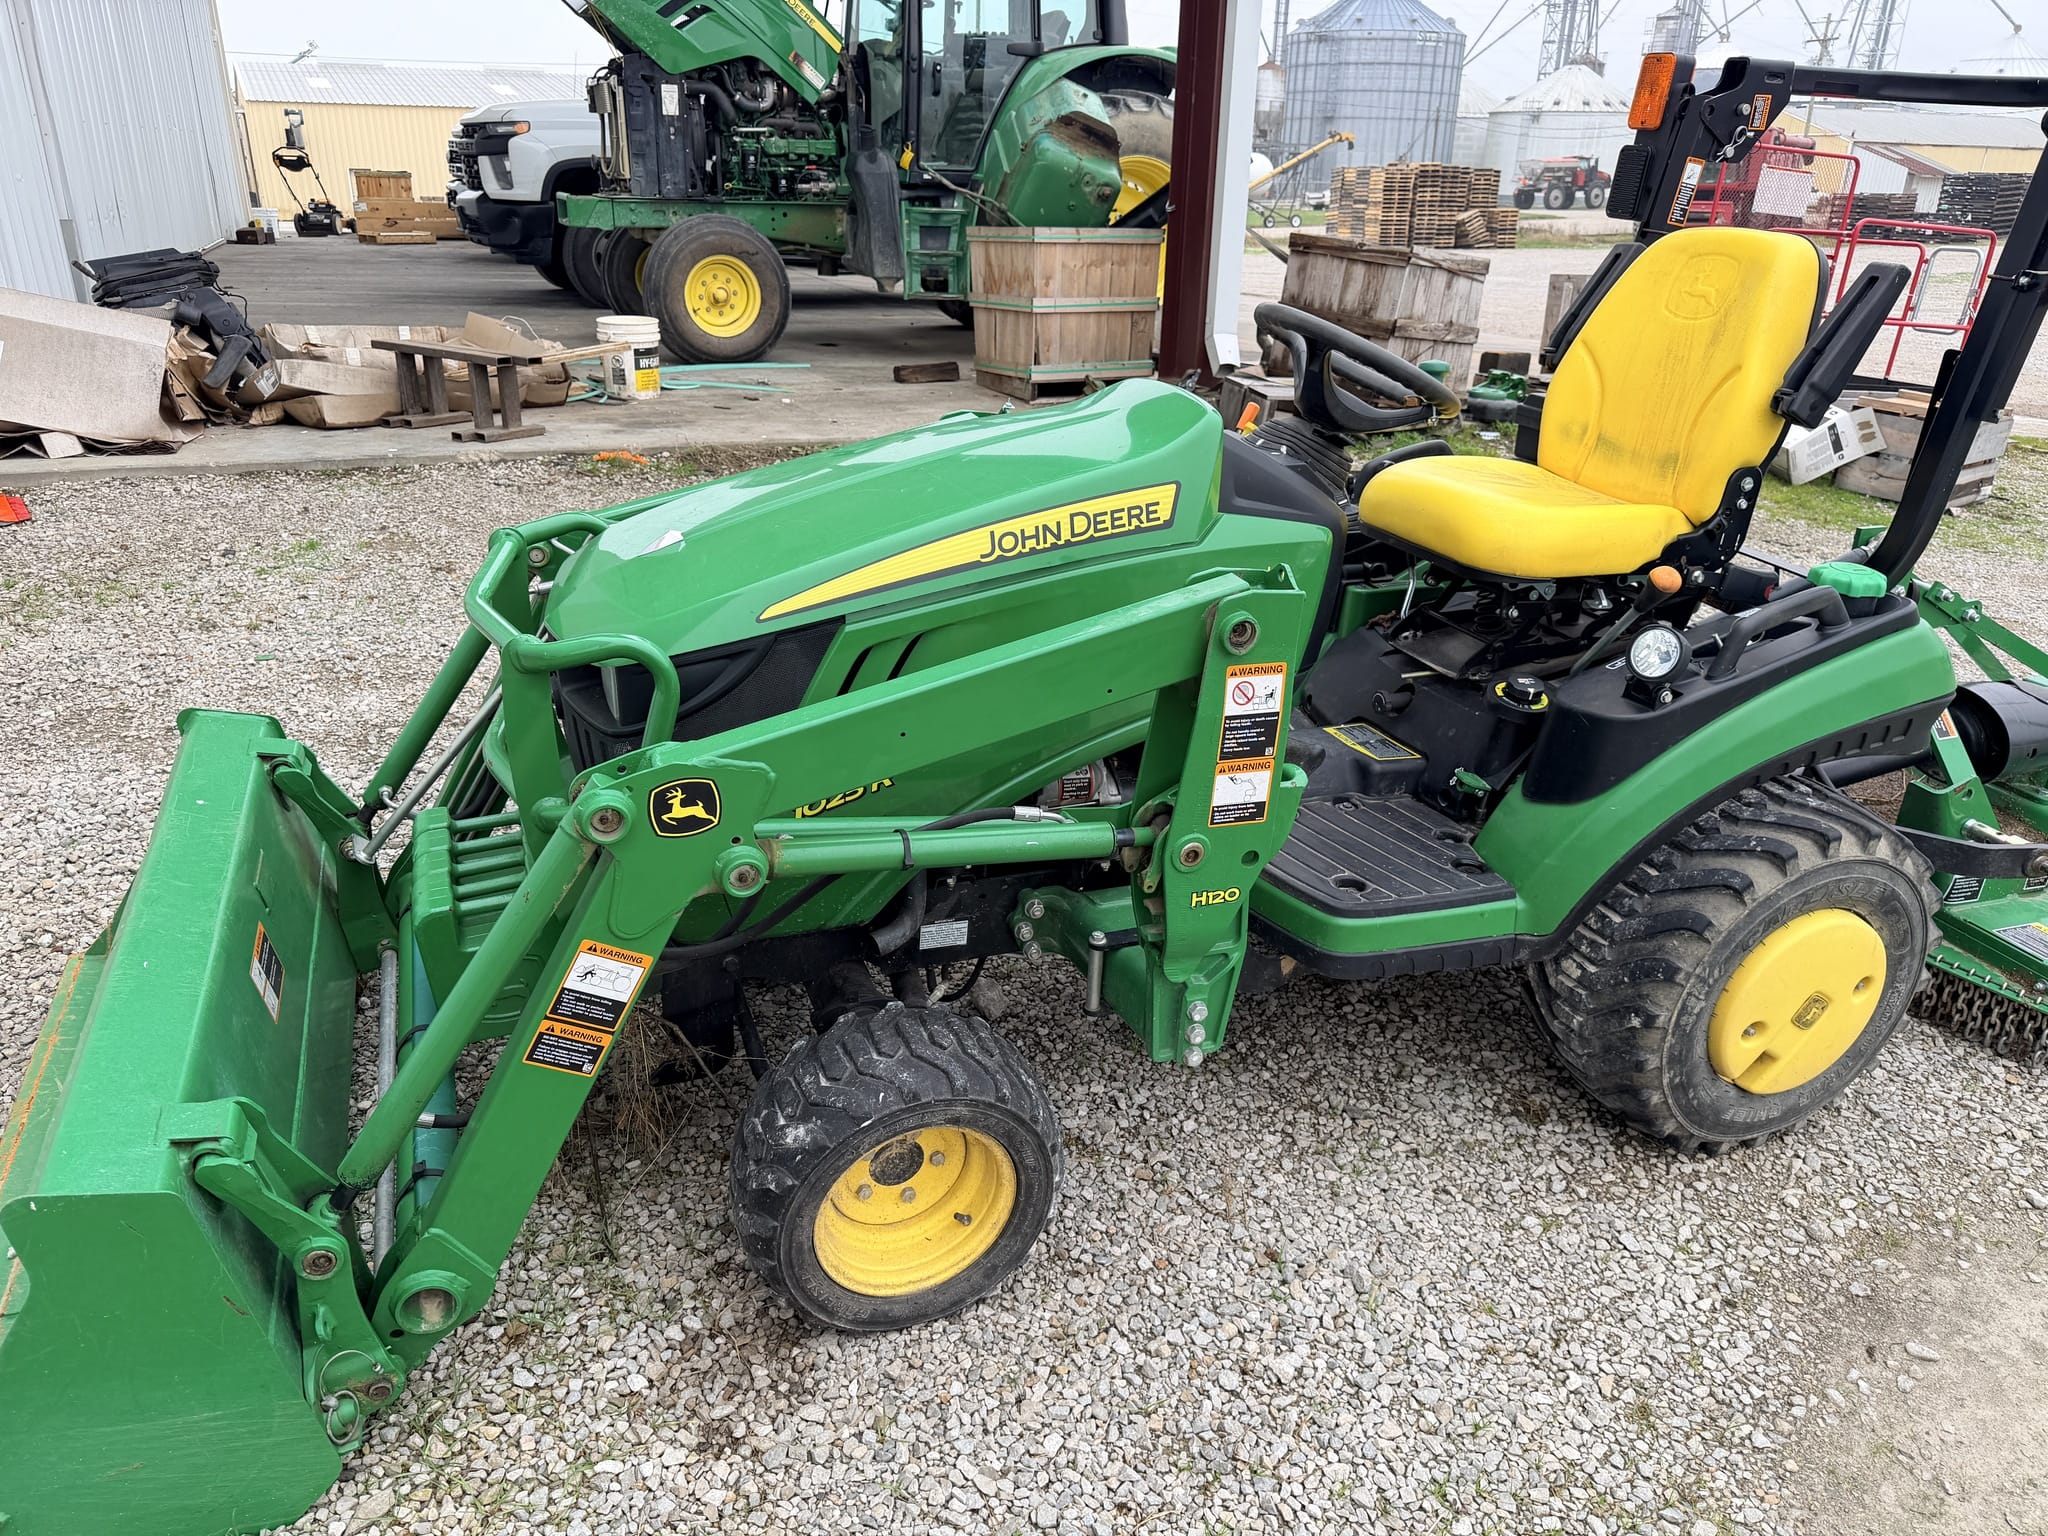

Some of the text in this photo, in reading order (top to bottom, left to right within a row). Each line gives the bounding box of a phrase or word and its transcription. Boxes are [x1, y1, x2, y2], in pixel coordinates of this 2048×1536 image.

[787, 0, 815, 27] DEERE
[980, 501, 1161, 559] JOHN DEERE
[1238, 664, 1284, 676] WARNING
[1227, 761, 1271, 773] WARNING
[1191, 887, 1241, 907] H120
[600, 946, 643, 964] WARNING
[559, 1027, 603, 1043] WARNING
